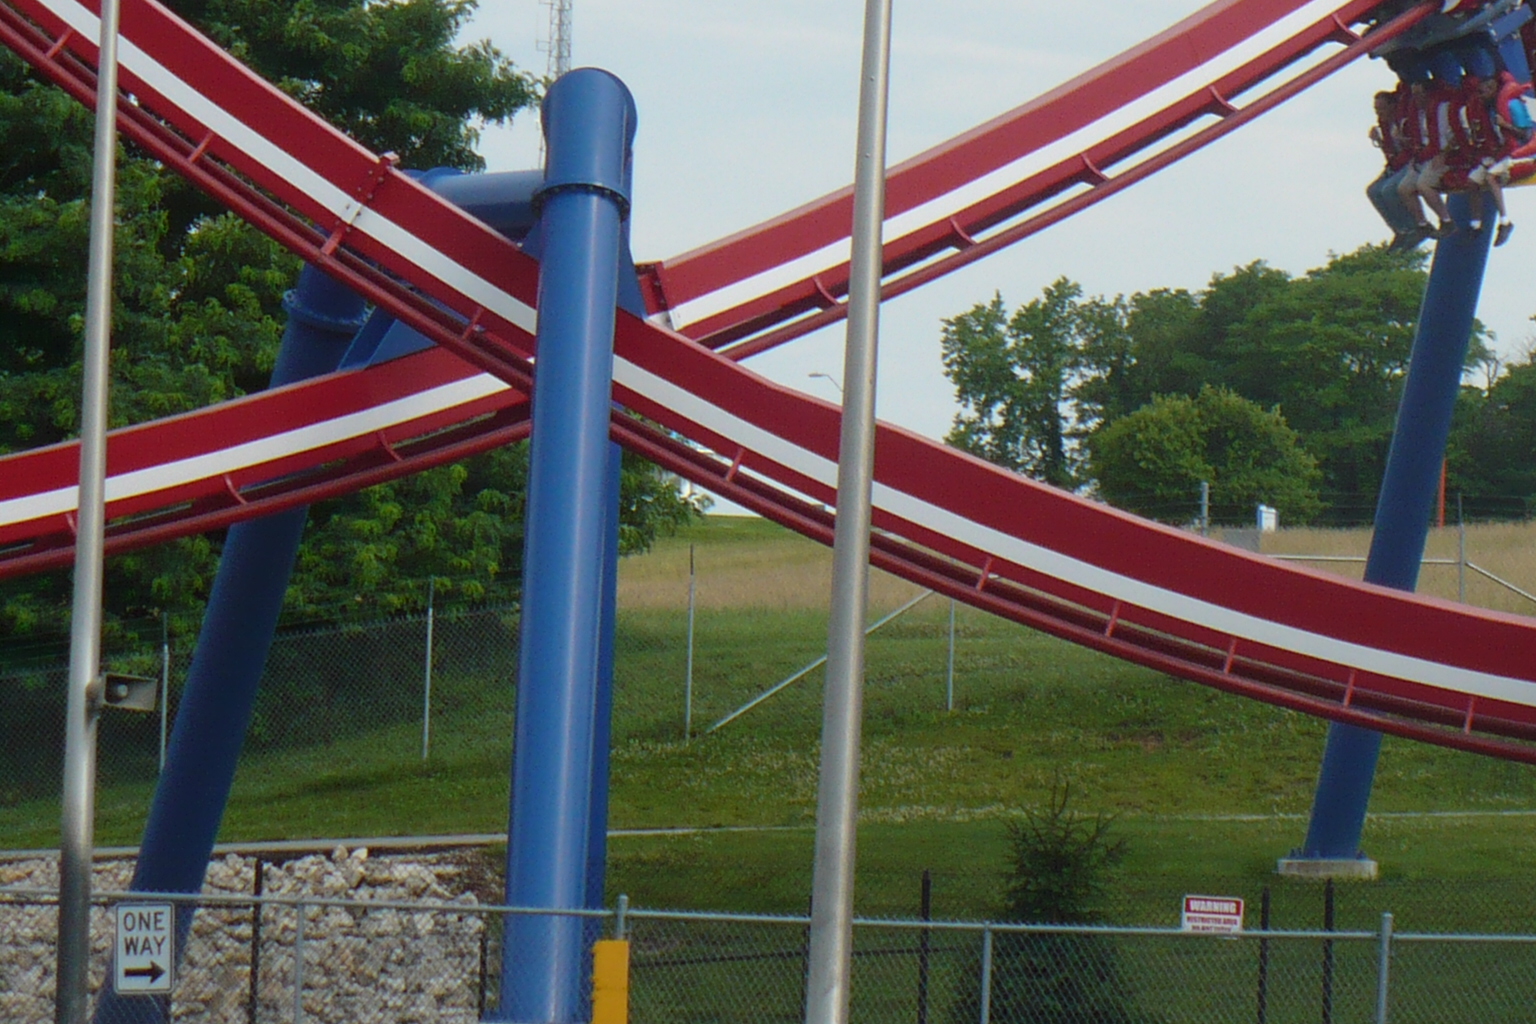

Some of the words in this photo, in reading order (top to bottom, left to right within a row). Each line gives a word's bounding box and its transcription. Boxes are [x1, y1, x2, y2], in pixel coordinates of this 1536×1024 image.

[1190, 900, 1237, 913] WARNING
[123, 911, 165, 932] ONE
[124, 935, 166, 956] WAY
